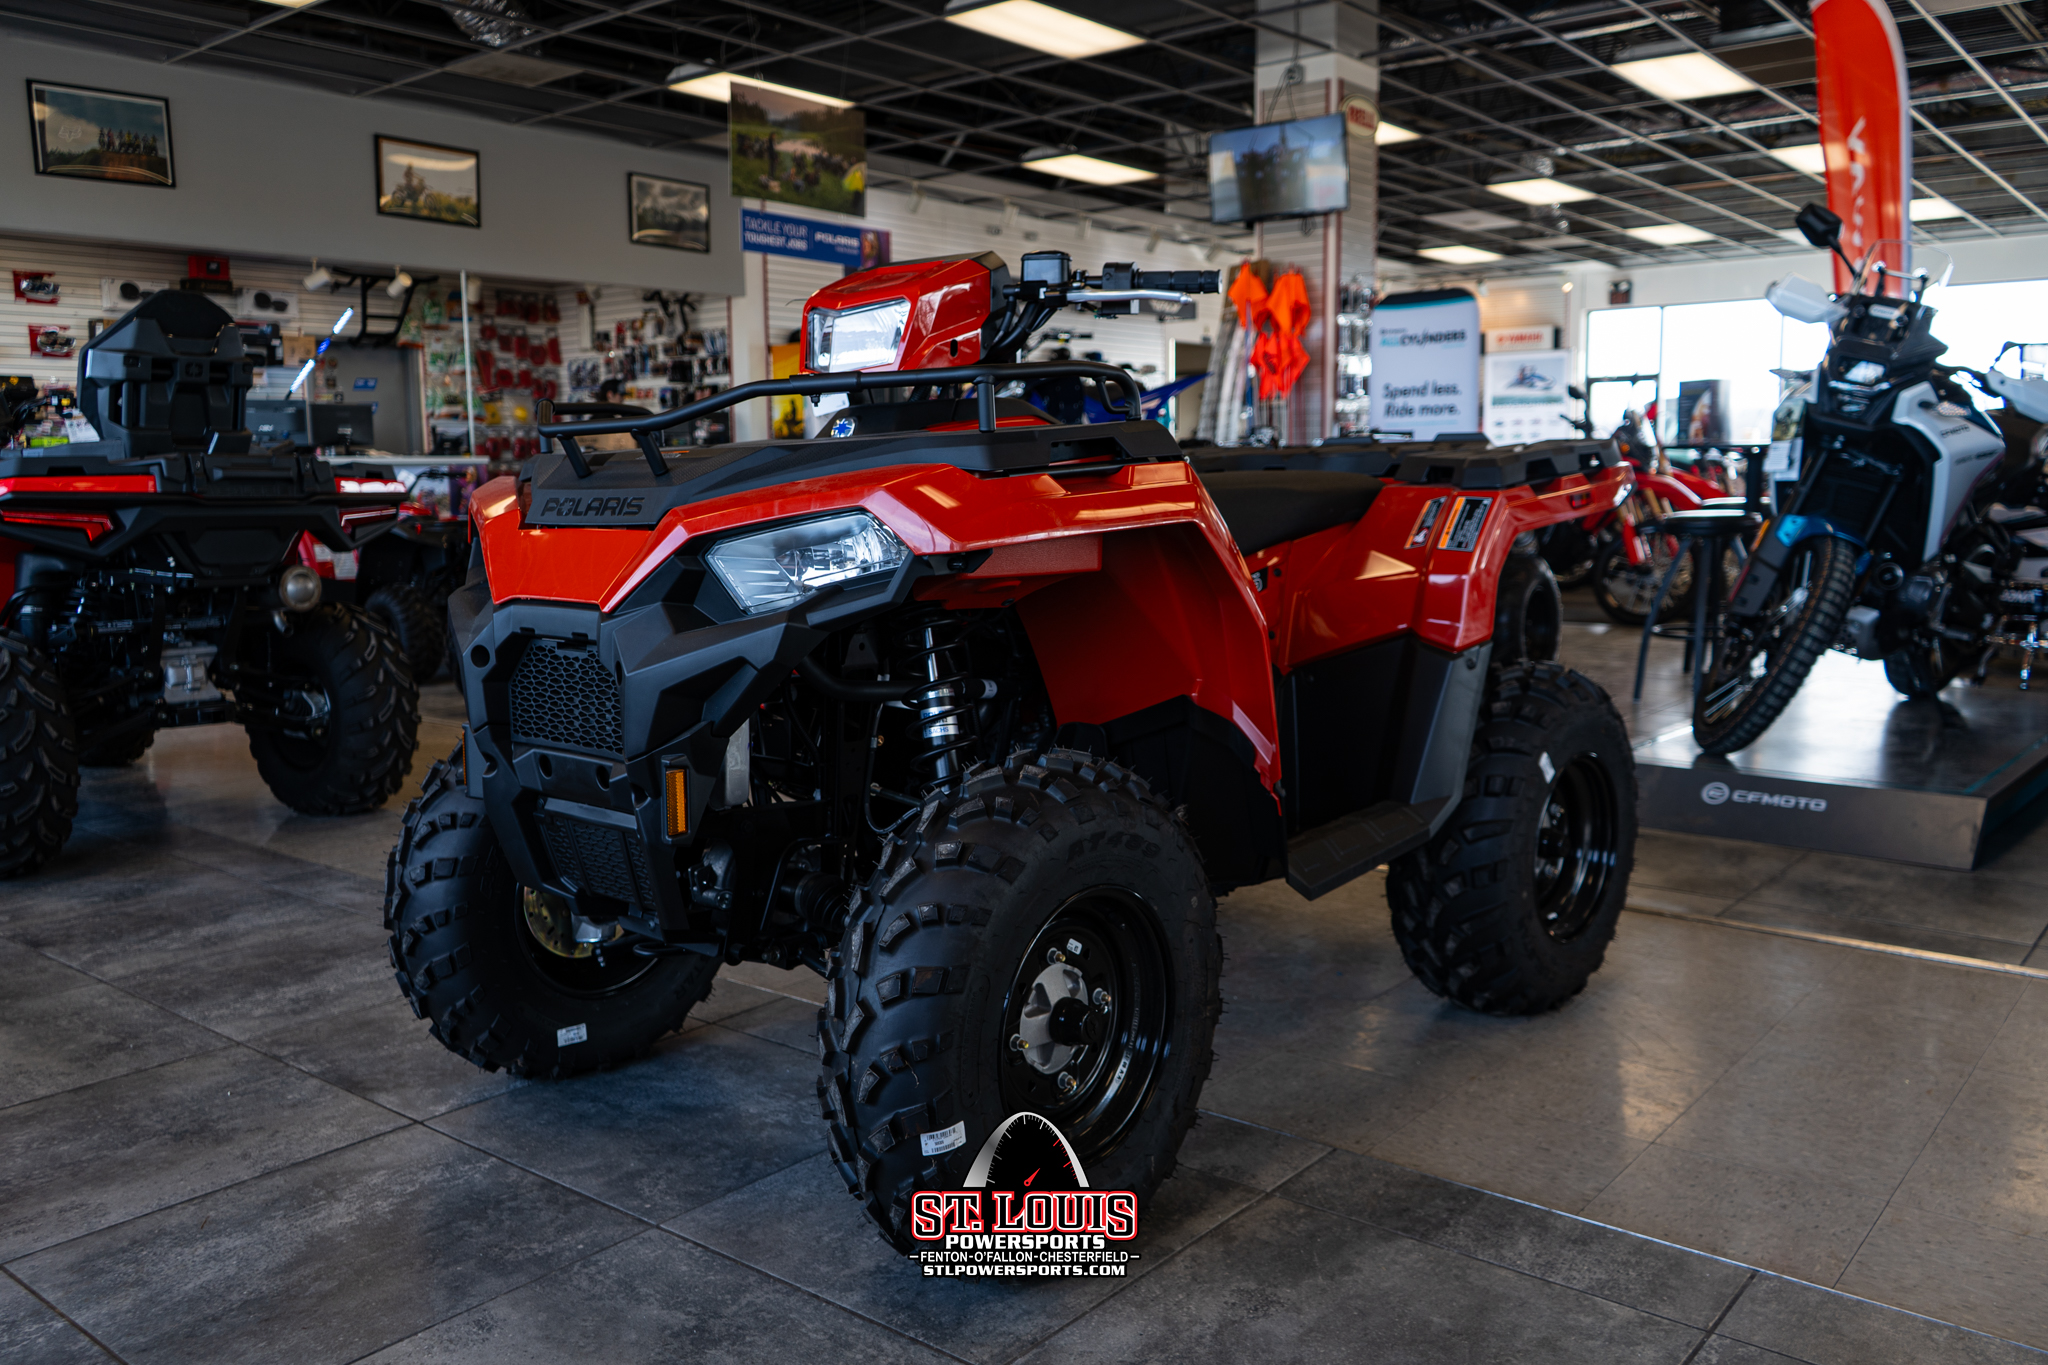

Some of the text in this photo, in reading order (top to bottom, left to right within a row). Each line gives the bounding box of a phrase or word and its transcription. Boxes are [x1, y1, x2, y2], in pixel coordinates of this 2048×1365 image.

[744, 216, 808, 238] TACKLE YOUR
[744, 231, 808, 251] TOUGHEST JOBS
[814, 231, 860, 248] POLARIS
[1383, 380, 1462, 401] Spend less.
[1384, 401, 1461, 418] Ride more.
[540, 497, 645, 517] POLARIS
[1732, 789, 1828, 812] CFMOTO
[1065, 830, 1161, 863] AT489
